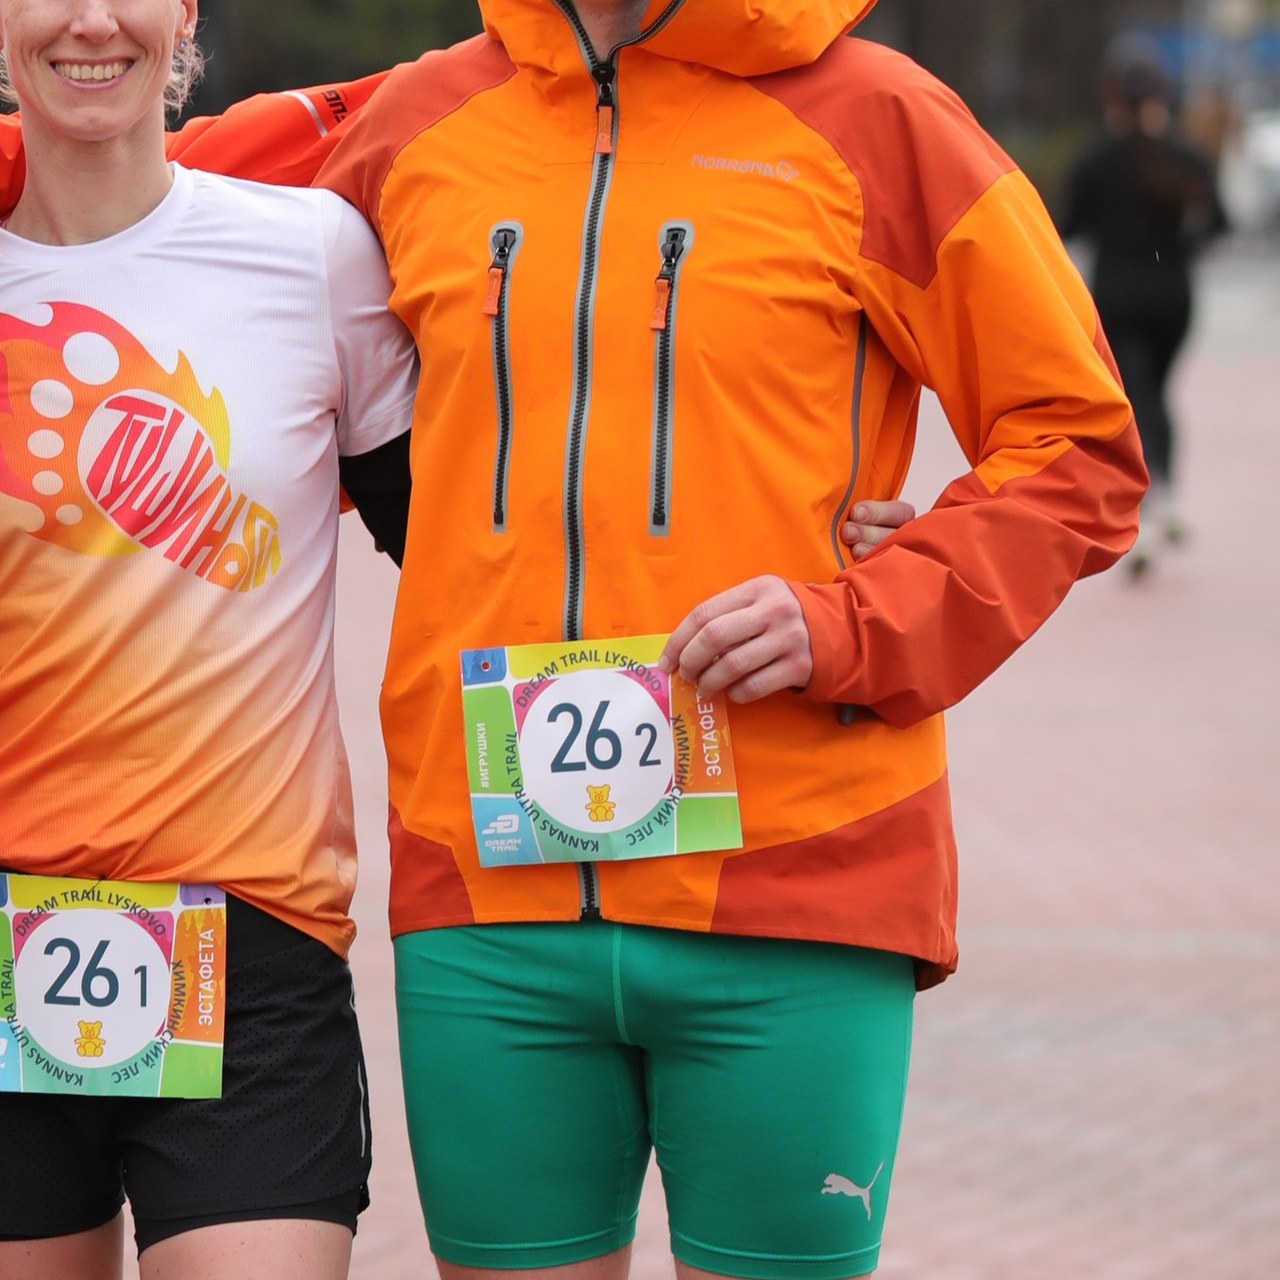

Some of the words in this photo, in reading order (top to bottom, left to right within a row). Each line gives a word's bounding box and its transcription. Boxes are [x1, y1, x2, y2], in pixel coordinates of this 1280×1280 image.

[516, 661, 559, 709] DREAM
[560, 650, 600, 668] TRAIL
[604, 650, 662, 692] LYSKOVO
[477, 722, 490, 788] #ИГРУШКИ
[506, 731, 518, 775] TRAIL
[546, 700, 622, 772] 26
[635, 723, 661, 766] 2
[696, 686, 721, 777] ЭСТАФЕТ
[656, 714, 690, 830] ХИМКИНСКИЙ
[540, 820, 599, 851] KANNAS
[626, 824, 653, 846] ЛЕС
[15, 896, 58, 937] DREAM
[61, 889, 103, 903] TRAIL
[108, 892, 166, 937] LYSKOVO
[1, 958, 15, 1000] TRAIL
[43, 937, 119, 1007] 26
[134, 965, 147, 1007] 1
[198, 929, 214, 1026] ЭСТАФЕТА
[143, 960, 186, 1069] ХИМКИНСКИЙ
[26, 1047, 83, 1086] KANNAS
[112, 1064, 139, 1084] ЛЕС
